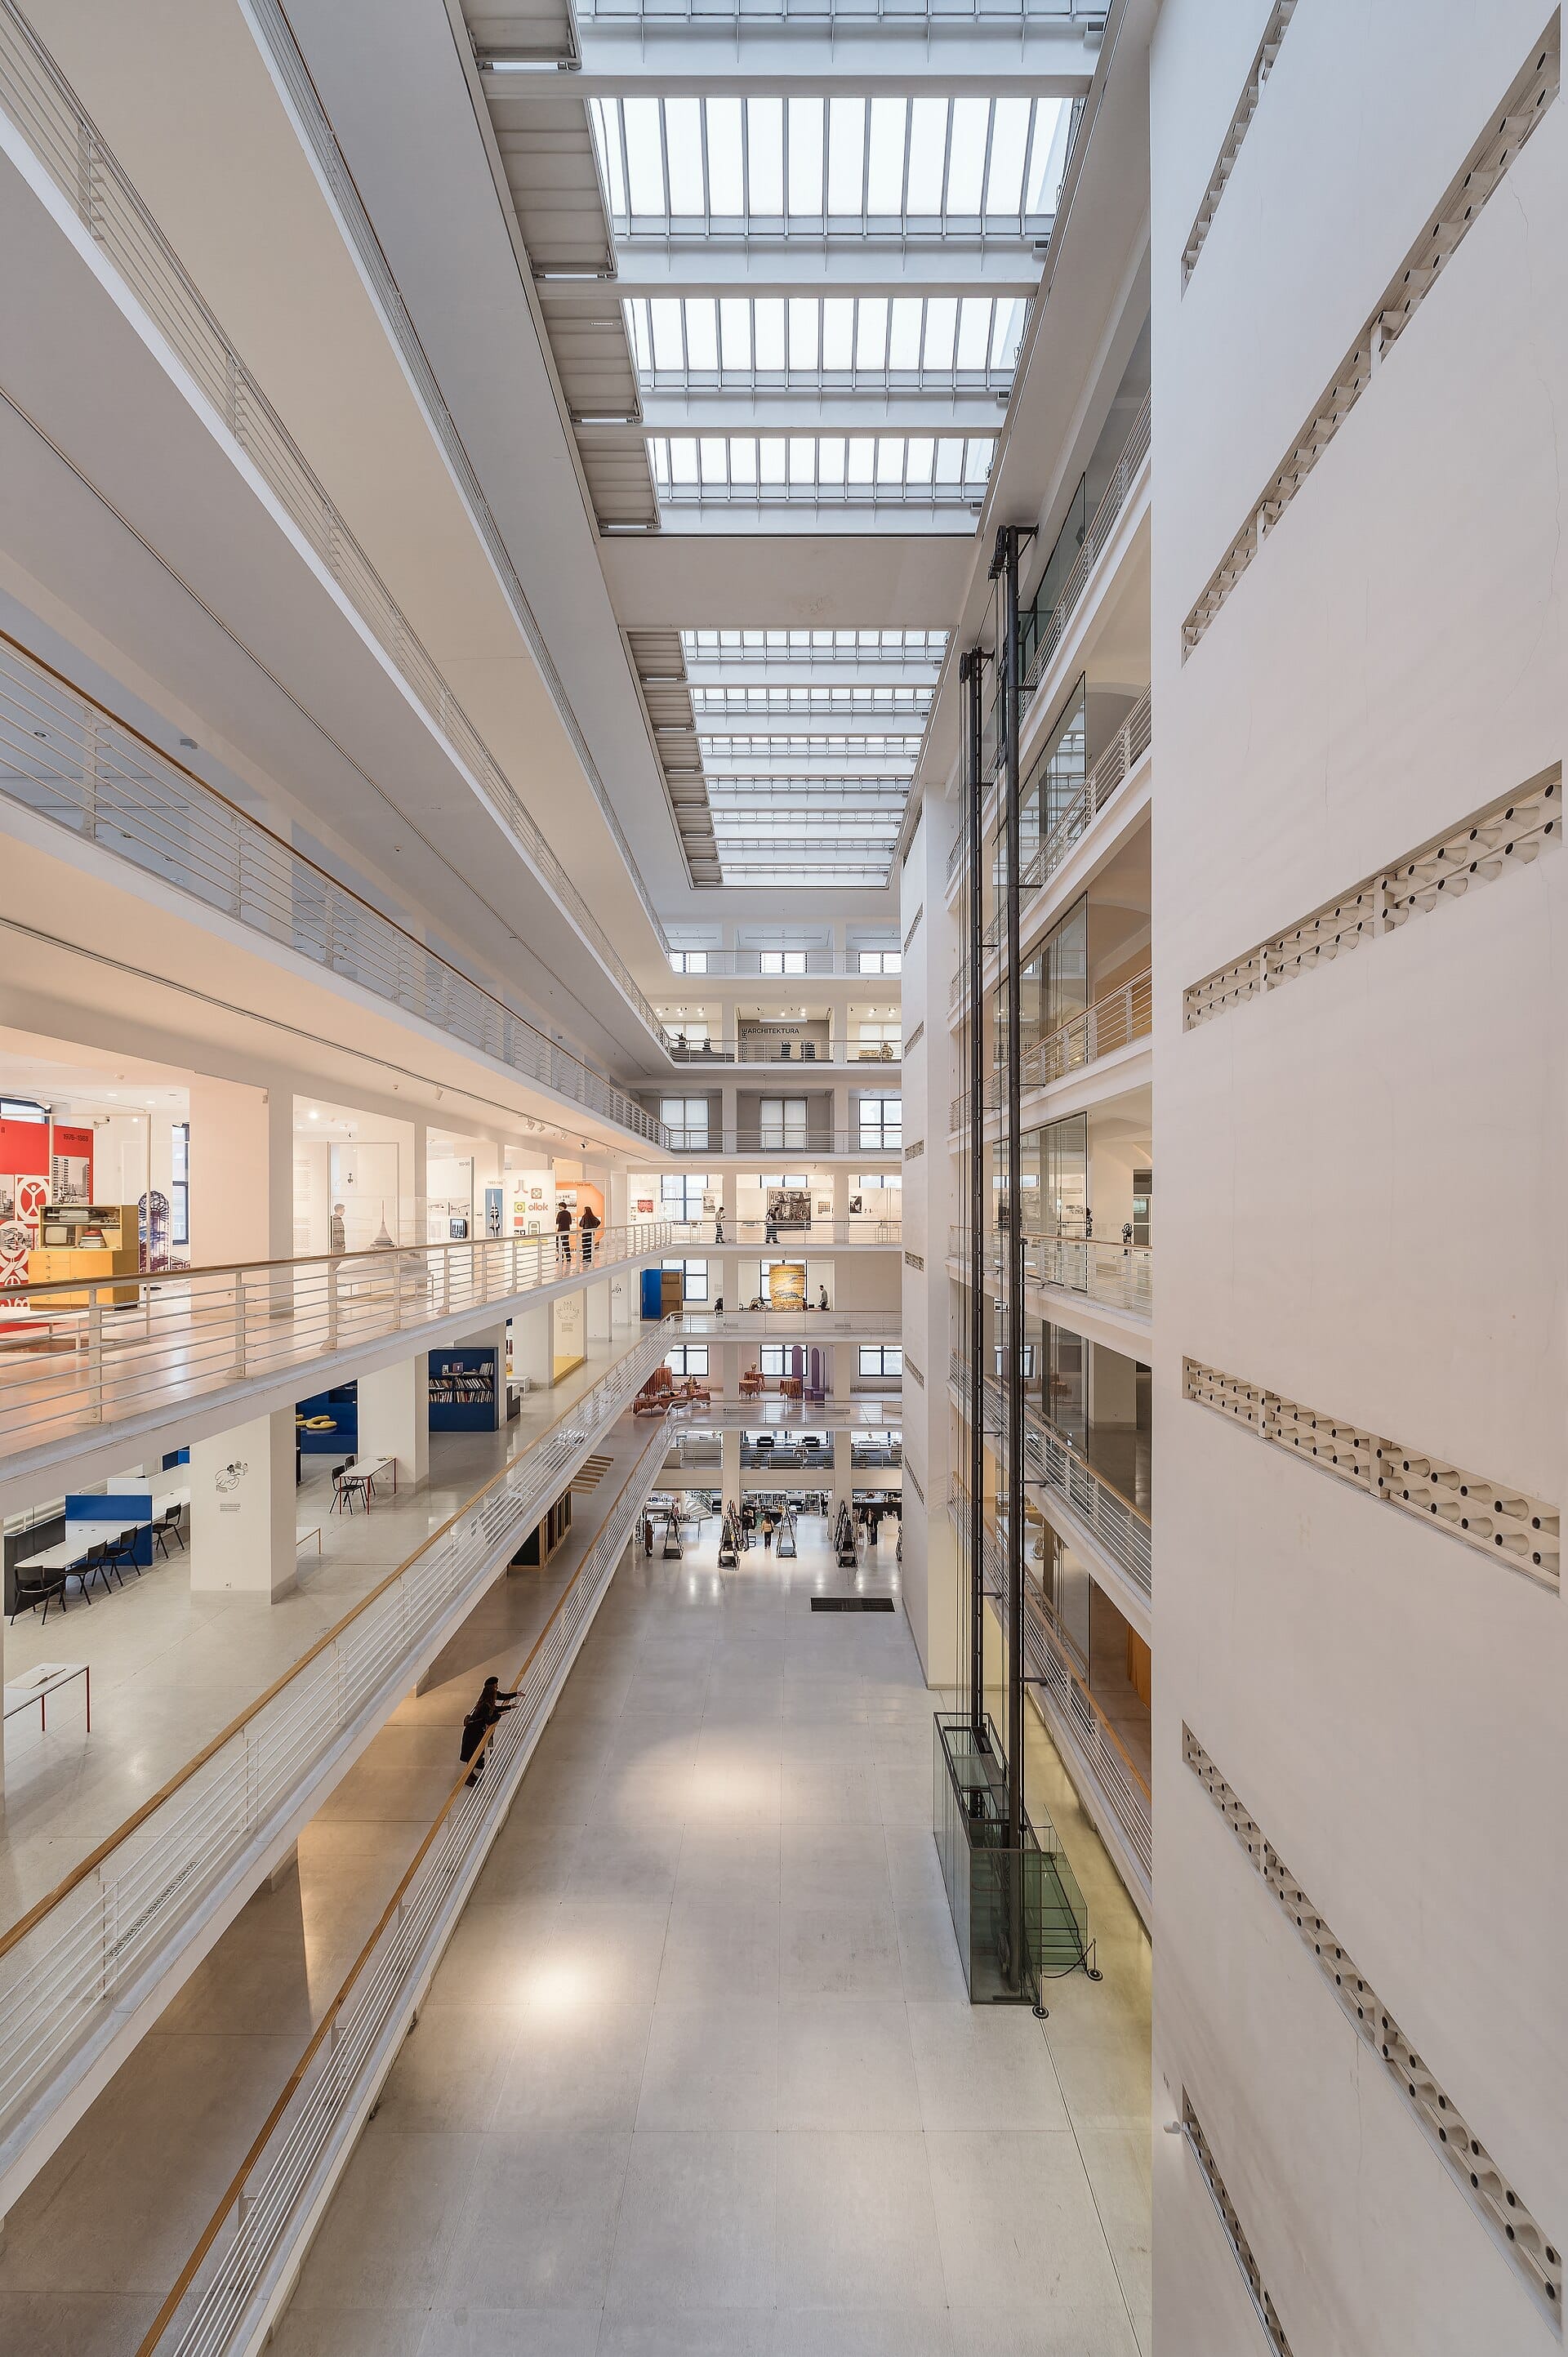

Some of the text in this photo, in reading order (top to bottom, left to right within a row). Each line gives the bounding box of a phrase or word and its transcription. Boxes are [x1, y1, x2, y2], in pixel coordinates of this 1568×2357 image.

[105, 1861, 198, 1958] DO NOT LEAN OVER THE RAILINGS
